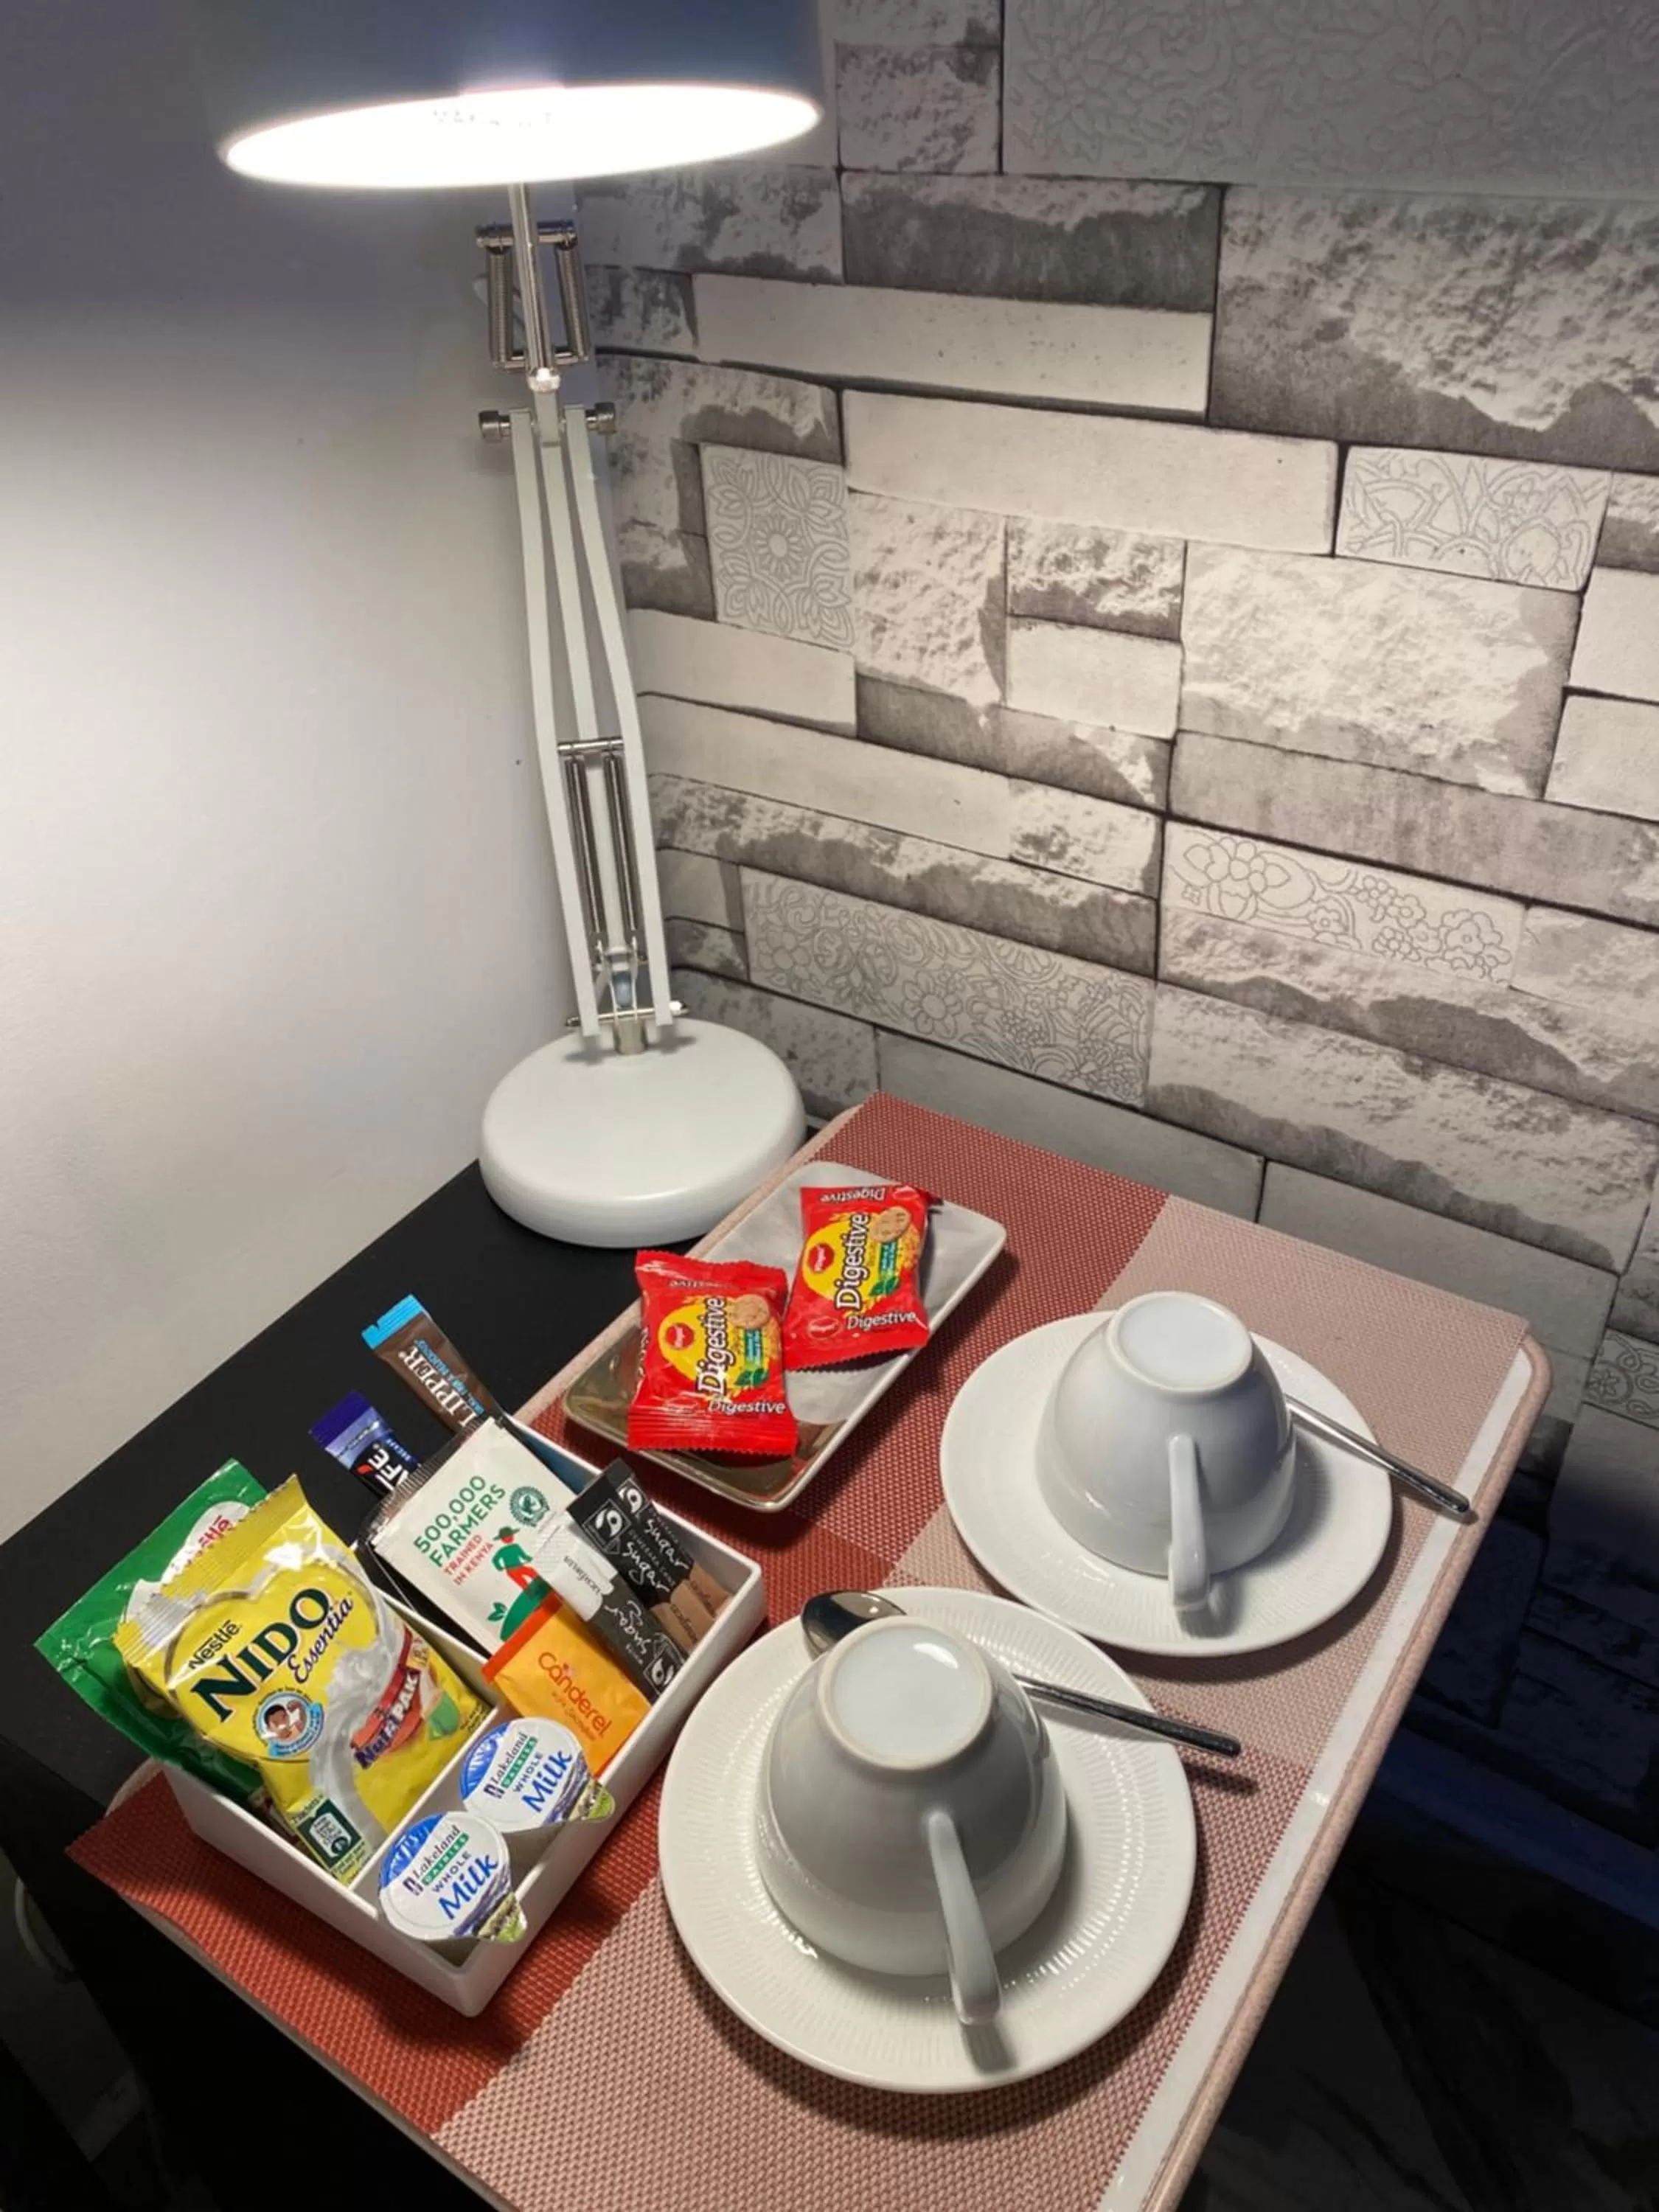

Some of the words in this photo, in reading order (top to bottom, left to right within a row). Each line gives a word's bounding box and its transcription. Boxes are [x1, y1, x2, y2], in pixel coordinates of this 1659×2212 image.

[836, 1211, 872, 1310] Digestive
[696, 1296, 737, 1397] Digestive
[847, 1310, 917, 1329] Digestive
[398, 1345, 478, 1427] LIPPER
[707, 1400, 786, 1415] Digestive
[413, 1475, 486, 1554] 500,000
[429, 1484, 507, 1568] FARMERS
[442, 1534, 483, 1576] TRAINED
[466, 1542, 494, 1573] KENYA
[190, 1588, 330, 1722] NIDO
[288, 1598, 354, 1683] Essentia
[538, 1652, 613, 1739] Canderel
[491, 1733, 527, 1783] Lakeland
[513, 1751, 543, 1792] WHOLE
[521, 1750, 572, 1812] Milk
[414, 1825, 461, 1878] Lakeland
[432, 1851, 473, 1893] WHOLE
[438, 1854, 498, 1920] Milk
